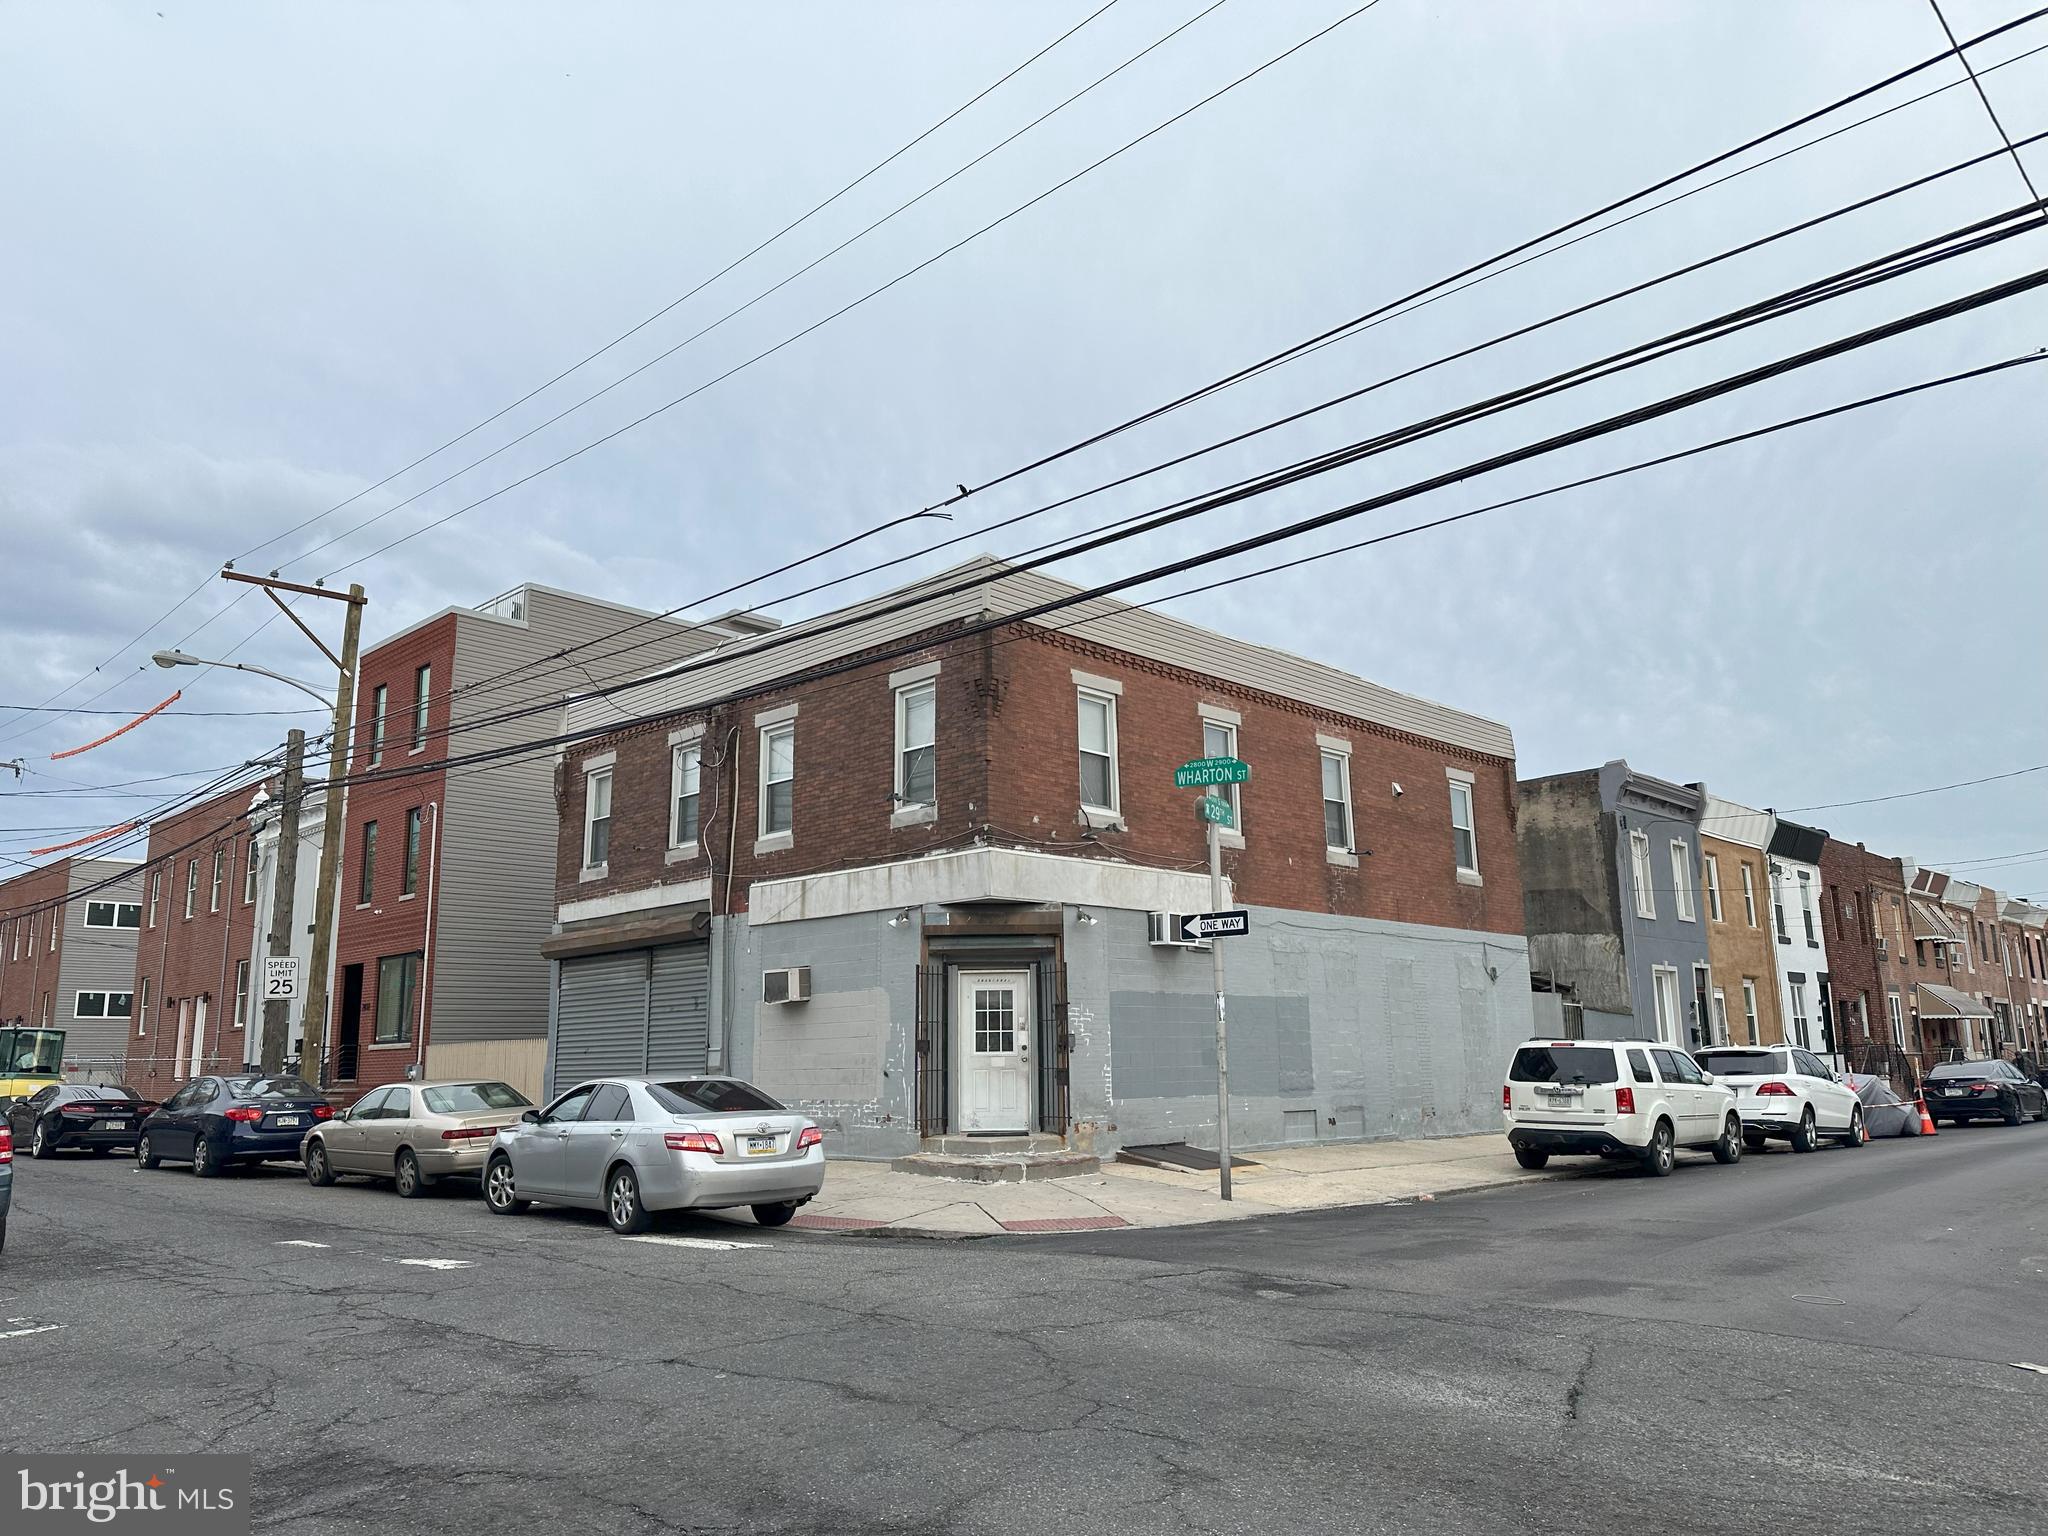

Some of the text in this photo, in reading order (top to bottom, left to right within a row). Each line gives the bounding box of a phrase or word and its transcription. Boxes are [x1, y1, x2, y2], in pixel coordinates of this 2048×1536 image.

[1206, 759, 1214, 767] W
[1177, 767, 1246, 785] WHARTON ST
[1200, 918, 1241, 931] ONE WAY
[268, 961, 297, 969] SPEED
[270, 969, 293, 977] LIMIT
[269, 979, 293, 994] 25
